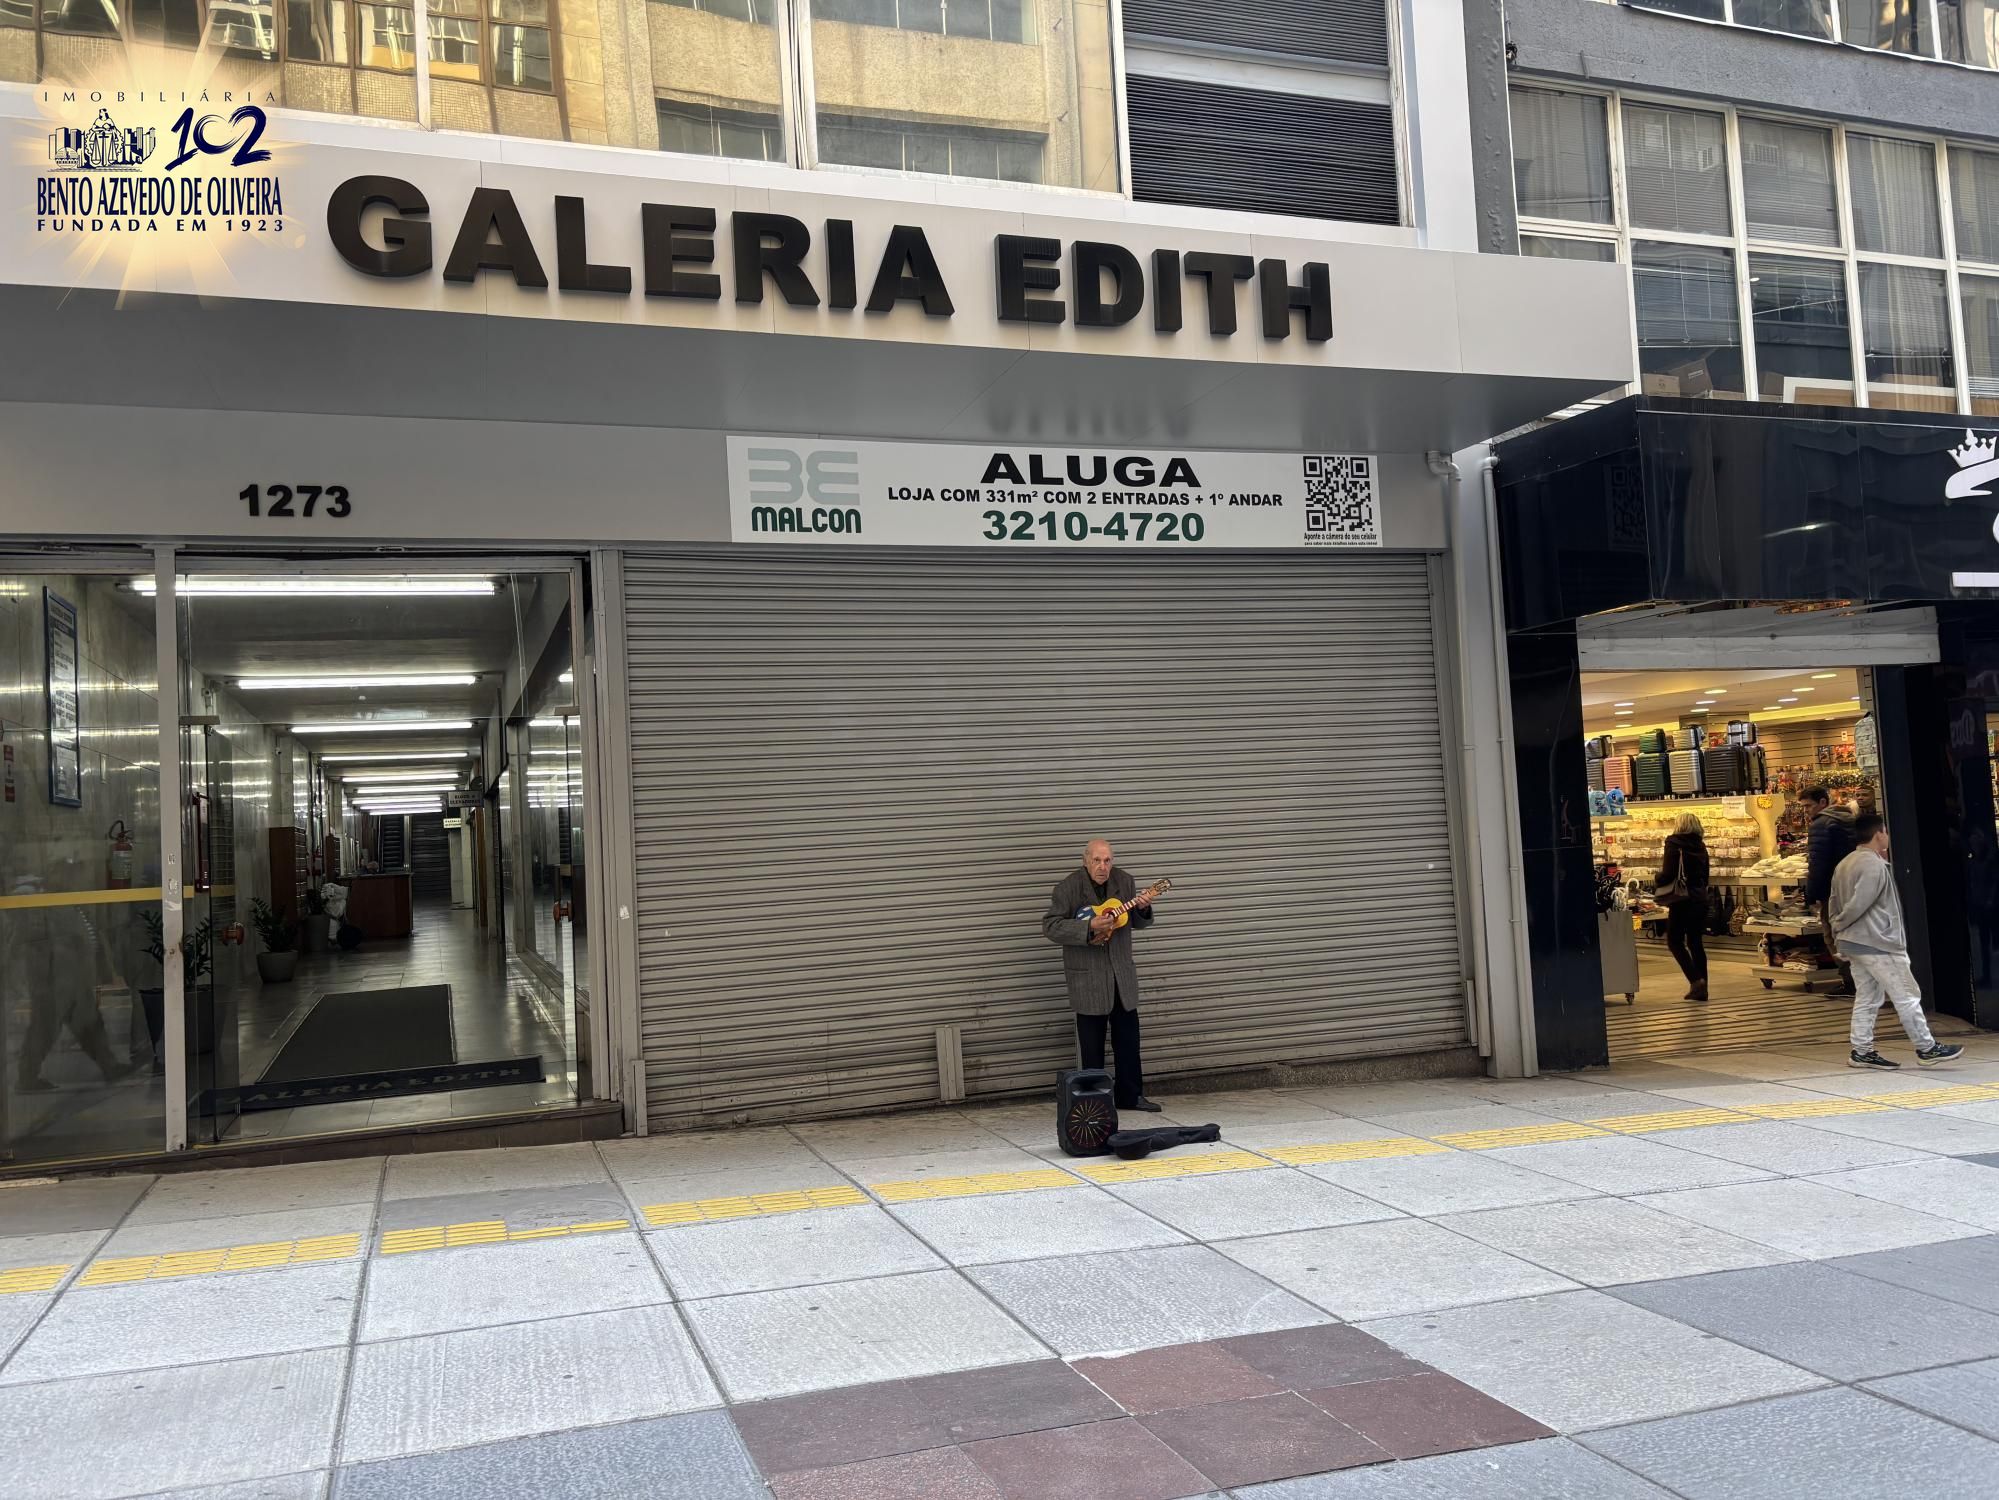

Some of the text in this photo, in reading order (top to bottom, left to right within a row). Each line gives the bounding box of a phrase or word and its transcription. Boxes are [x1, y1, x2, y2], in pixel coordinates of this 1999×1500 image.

[327, 174, 1334, 342] GALERIA EDITH
[980, 452, 1202, 488] ALUGA
[239, 484, 351, 518] 1273
[887, 486, 935, 502] LOJA
[940, 488, 980, 503] COM
[986, 490, 1038, 504] 331m²
[1043, 491, 1082, 505] COM
[1086, 492, 1097, 505] 2
[1101, 492, 1190, 506] ENTRADAS
[1194, 496, 1204, 505] +
[1228, 494, 1283, 507] ANDAR
[751, 506, 862, 534] MALCON
[982, 510, 1205, 542] 3210-4720
[1304, 532, 1321, 541] Aponte
[1344, 532, 1351, 540] do
